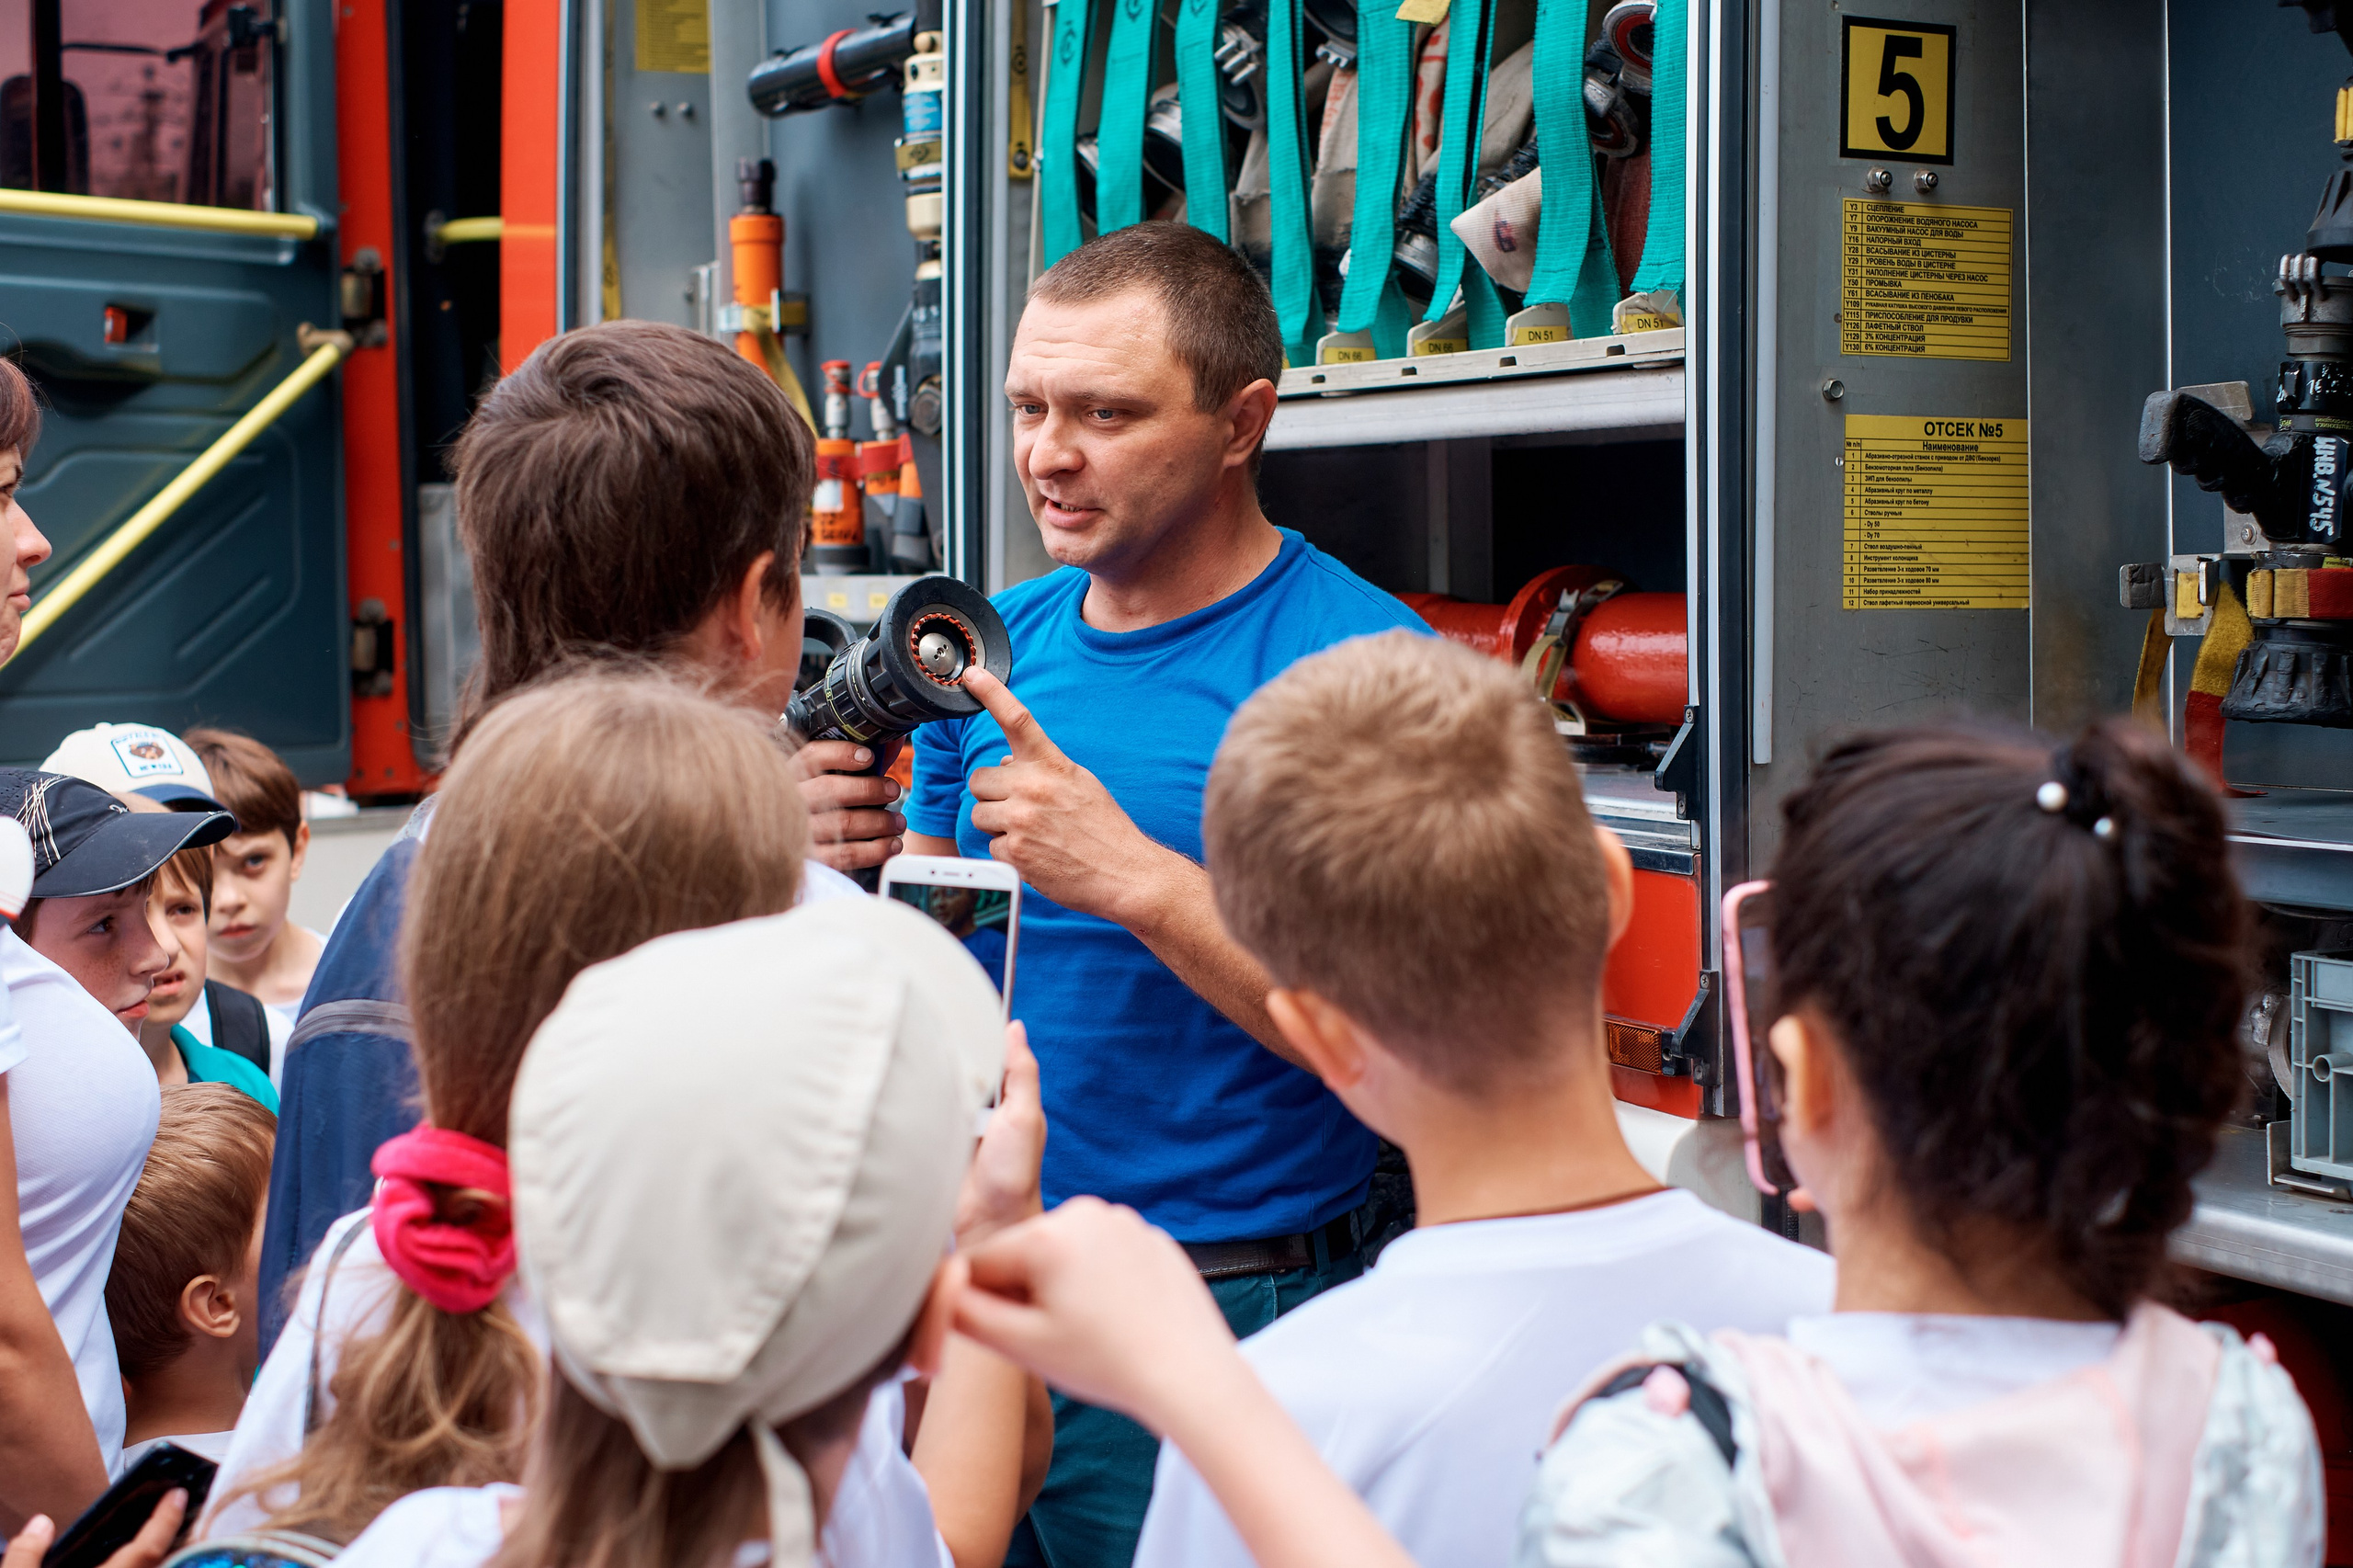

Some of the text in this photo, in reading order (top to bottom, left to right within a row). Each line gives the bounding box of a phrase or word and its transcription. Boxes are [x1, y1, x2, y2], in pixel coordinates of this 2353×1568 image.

[1876, 34, 1925, 151] 5
[1866, 204, 1904, 213] СЦЕПЛЕНИЕ
[1866, 214, 1915, 224] ОПОРОЖНЕНИЕ
[1916, 218, 1950, 226] ВОДЯНОГО
[1951, 221, 1978, 229] НАСОСА
[1866, 225, 1905, 234] ВАКУУМНЫЙ
[1906, 228, 1929, 236] НАСОС
[1930, 229, 1943, 237] ДЛЯ
[1945, 230, 1963, 238] ВОДЫ
[1866, 236, 1903, 244] НАПОРНЫЙ
[1904, 239, 1921, 247] ВХОД
[1866, 247, 1911, 256] ВСАСЫВАНИЕ
[1921, 250, 1956, 259] ЦИСТЕРНЫ
[1866, 257, 1895, 267] УРОВЕНЬ
[1897, 259, 1915, 267] ВОДЫ
[1923, 261, 1956, 269] ЦИСТЕРНЕ
[1866, 268, 1908, 278] НАПОЛНЕНИЕ
[1910, 271, 1945, 279] ЦИСТЕРНЫ
[1946, 273, 1965, 281] ЧЕРЕЗ
[1967, 274, 1988, 282] НАСОС
[1866, 279, 1903, 288] ПРОМЫВКА
[1866, 290, 1910, 299] ВСАСЫВАНИЕ
[1921, 292, 1954, 301] ПЕНОБАКА
[1637, 318, 1664, 329] DN 51
[1866, 312, 1925, 322] ПРИСПОСОБЛЕНИЕ
[1927, 314, 1938, 323] ДЛЯ
[1940, 315, 1973, 324] ПРОДУВКИ
[1865, 322, 1901, 331] ЛАФЕТНЫЙ
[1903, 324, 1924, 332] СТВОЛ
[1528, 330, 1553, 341] DN 51
[1875, 334, 1925, 343] КОНЦЕНТРАЦИЯ
[1428, 343, 1441, 353] DN
[1875, 344, 1925, 354] КОНЦЕНТРАЦИЯ
[1338, 351, 1350, 360] DN
[1924, 421, 2003, 437] ОТСЕК №5
[1923, 441, 1979, 451] Наименование
